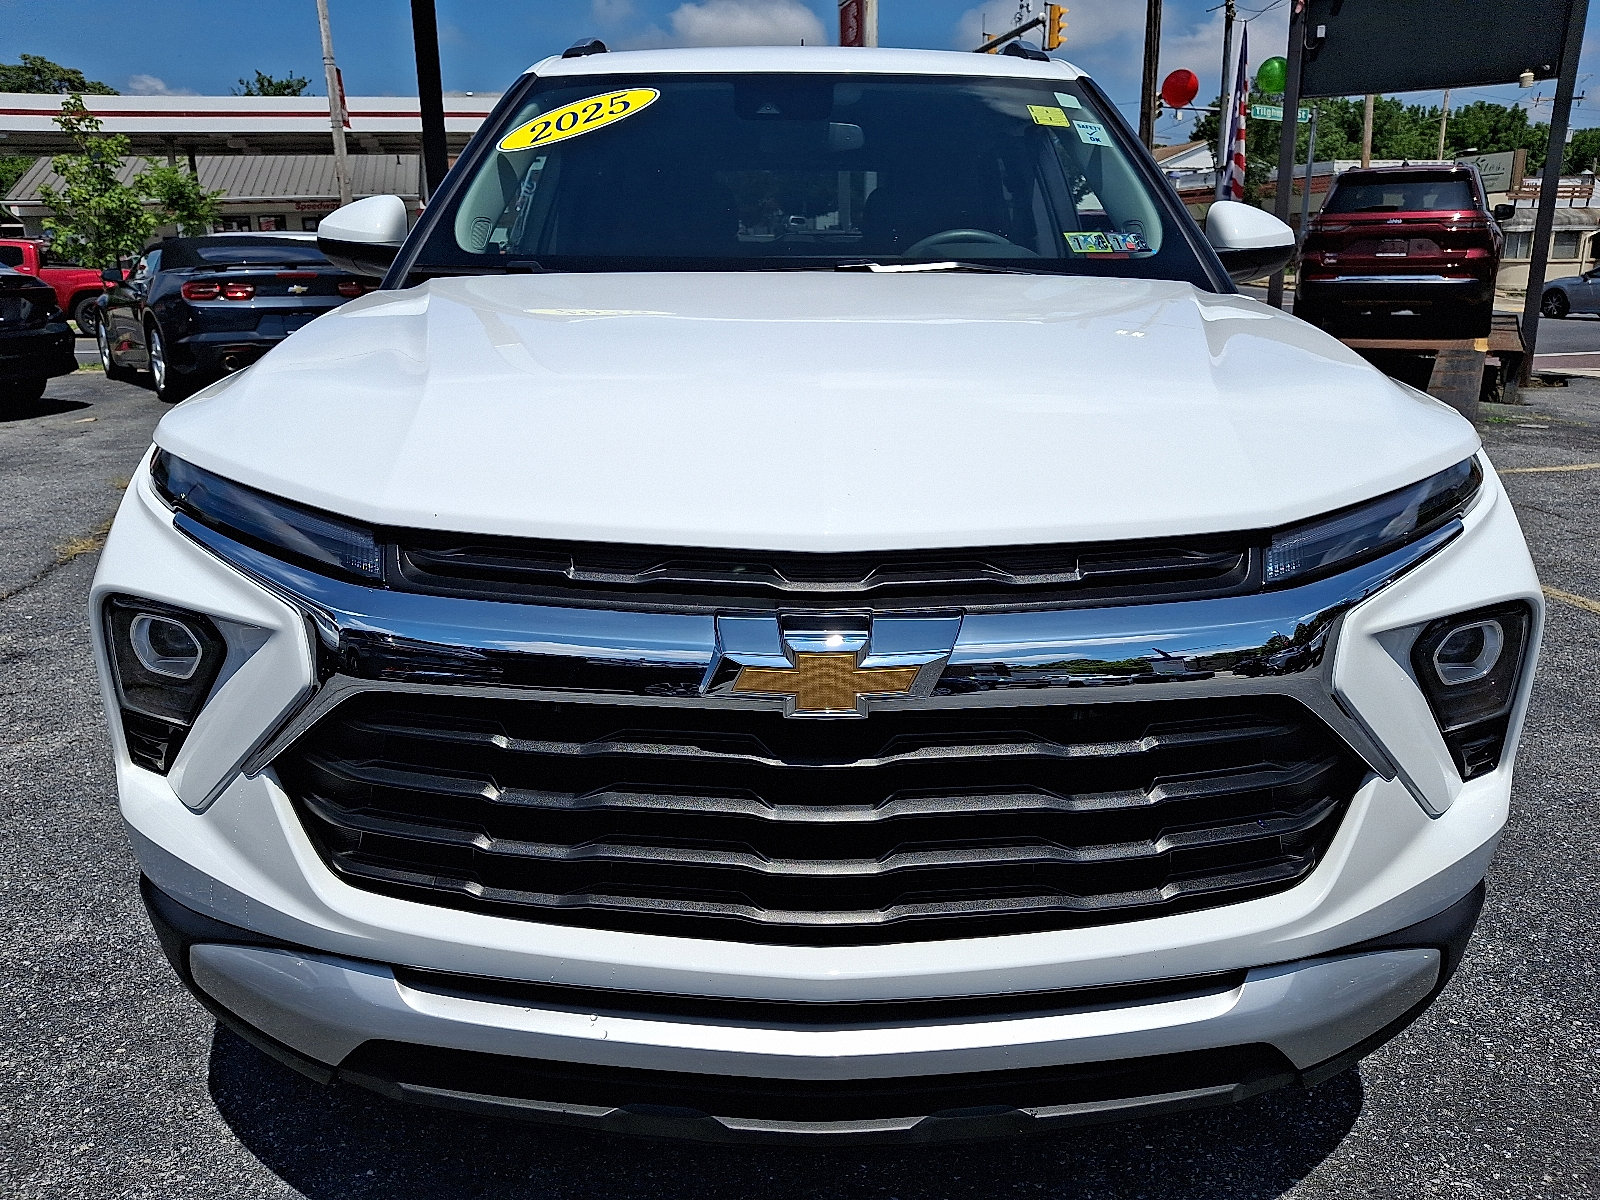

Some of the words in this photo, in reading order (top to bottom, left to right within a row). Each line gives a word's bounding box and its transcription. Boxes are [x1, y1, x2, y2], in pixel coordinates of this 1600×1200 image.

[529, 93, 631, 144] 2025
[1256, 106, 1284, 119] Tilghm
[1298, 110, 1307, 119] St
[1077, 123, 1101, 132] SAFETY
